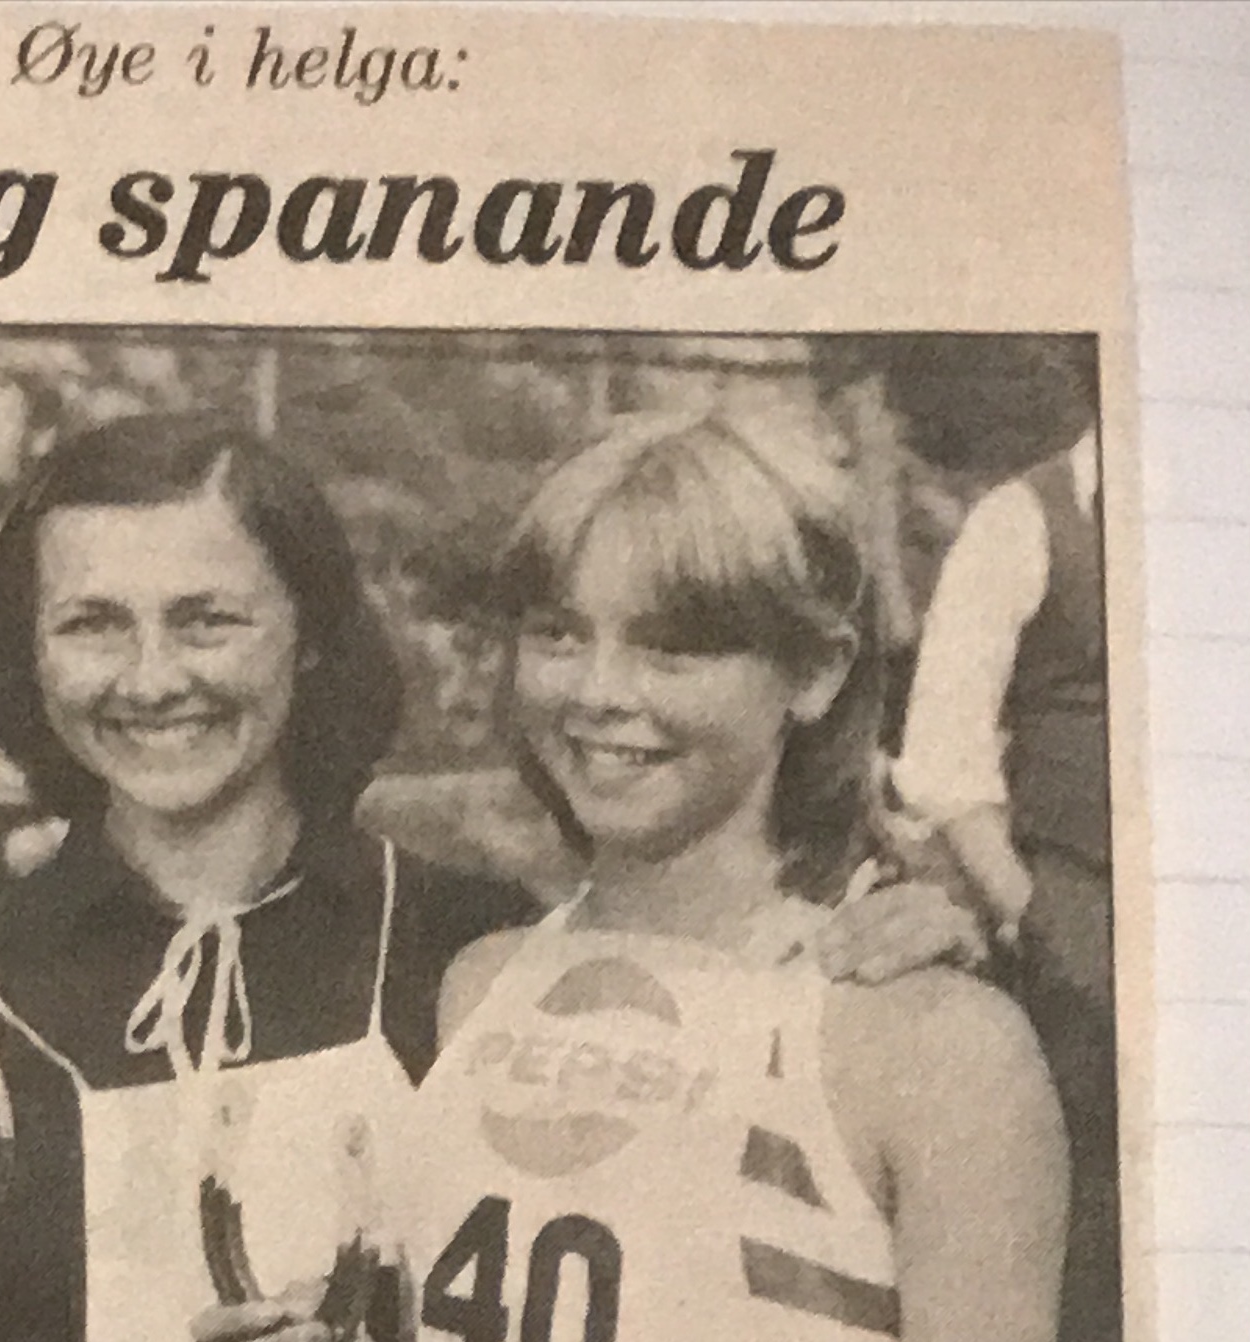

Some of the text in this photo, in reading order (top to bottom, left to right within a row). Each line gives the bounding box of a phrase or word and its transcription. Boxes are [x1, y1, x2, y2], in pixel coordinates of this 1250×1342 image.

[11, 18, 157, 100] Øye
[188, 24, 216, 90] i
[246, 25, 468, 106] helga:
[99, 148, 846, 285] spanande
[464, 1030, 720, 1112] PEPSI
